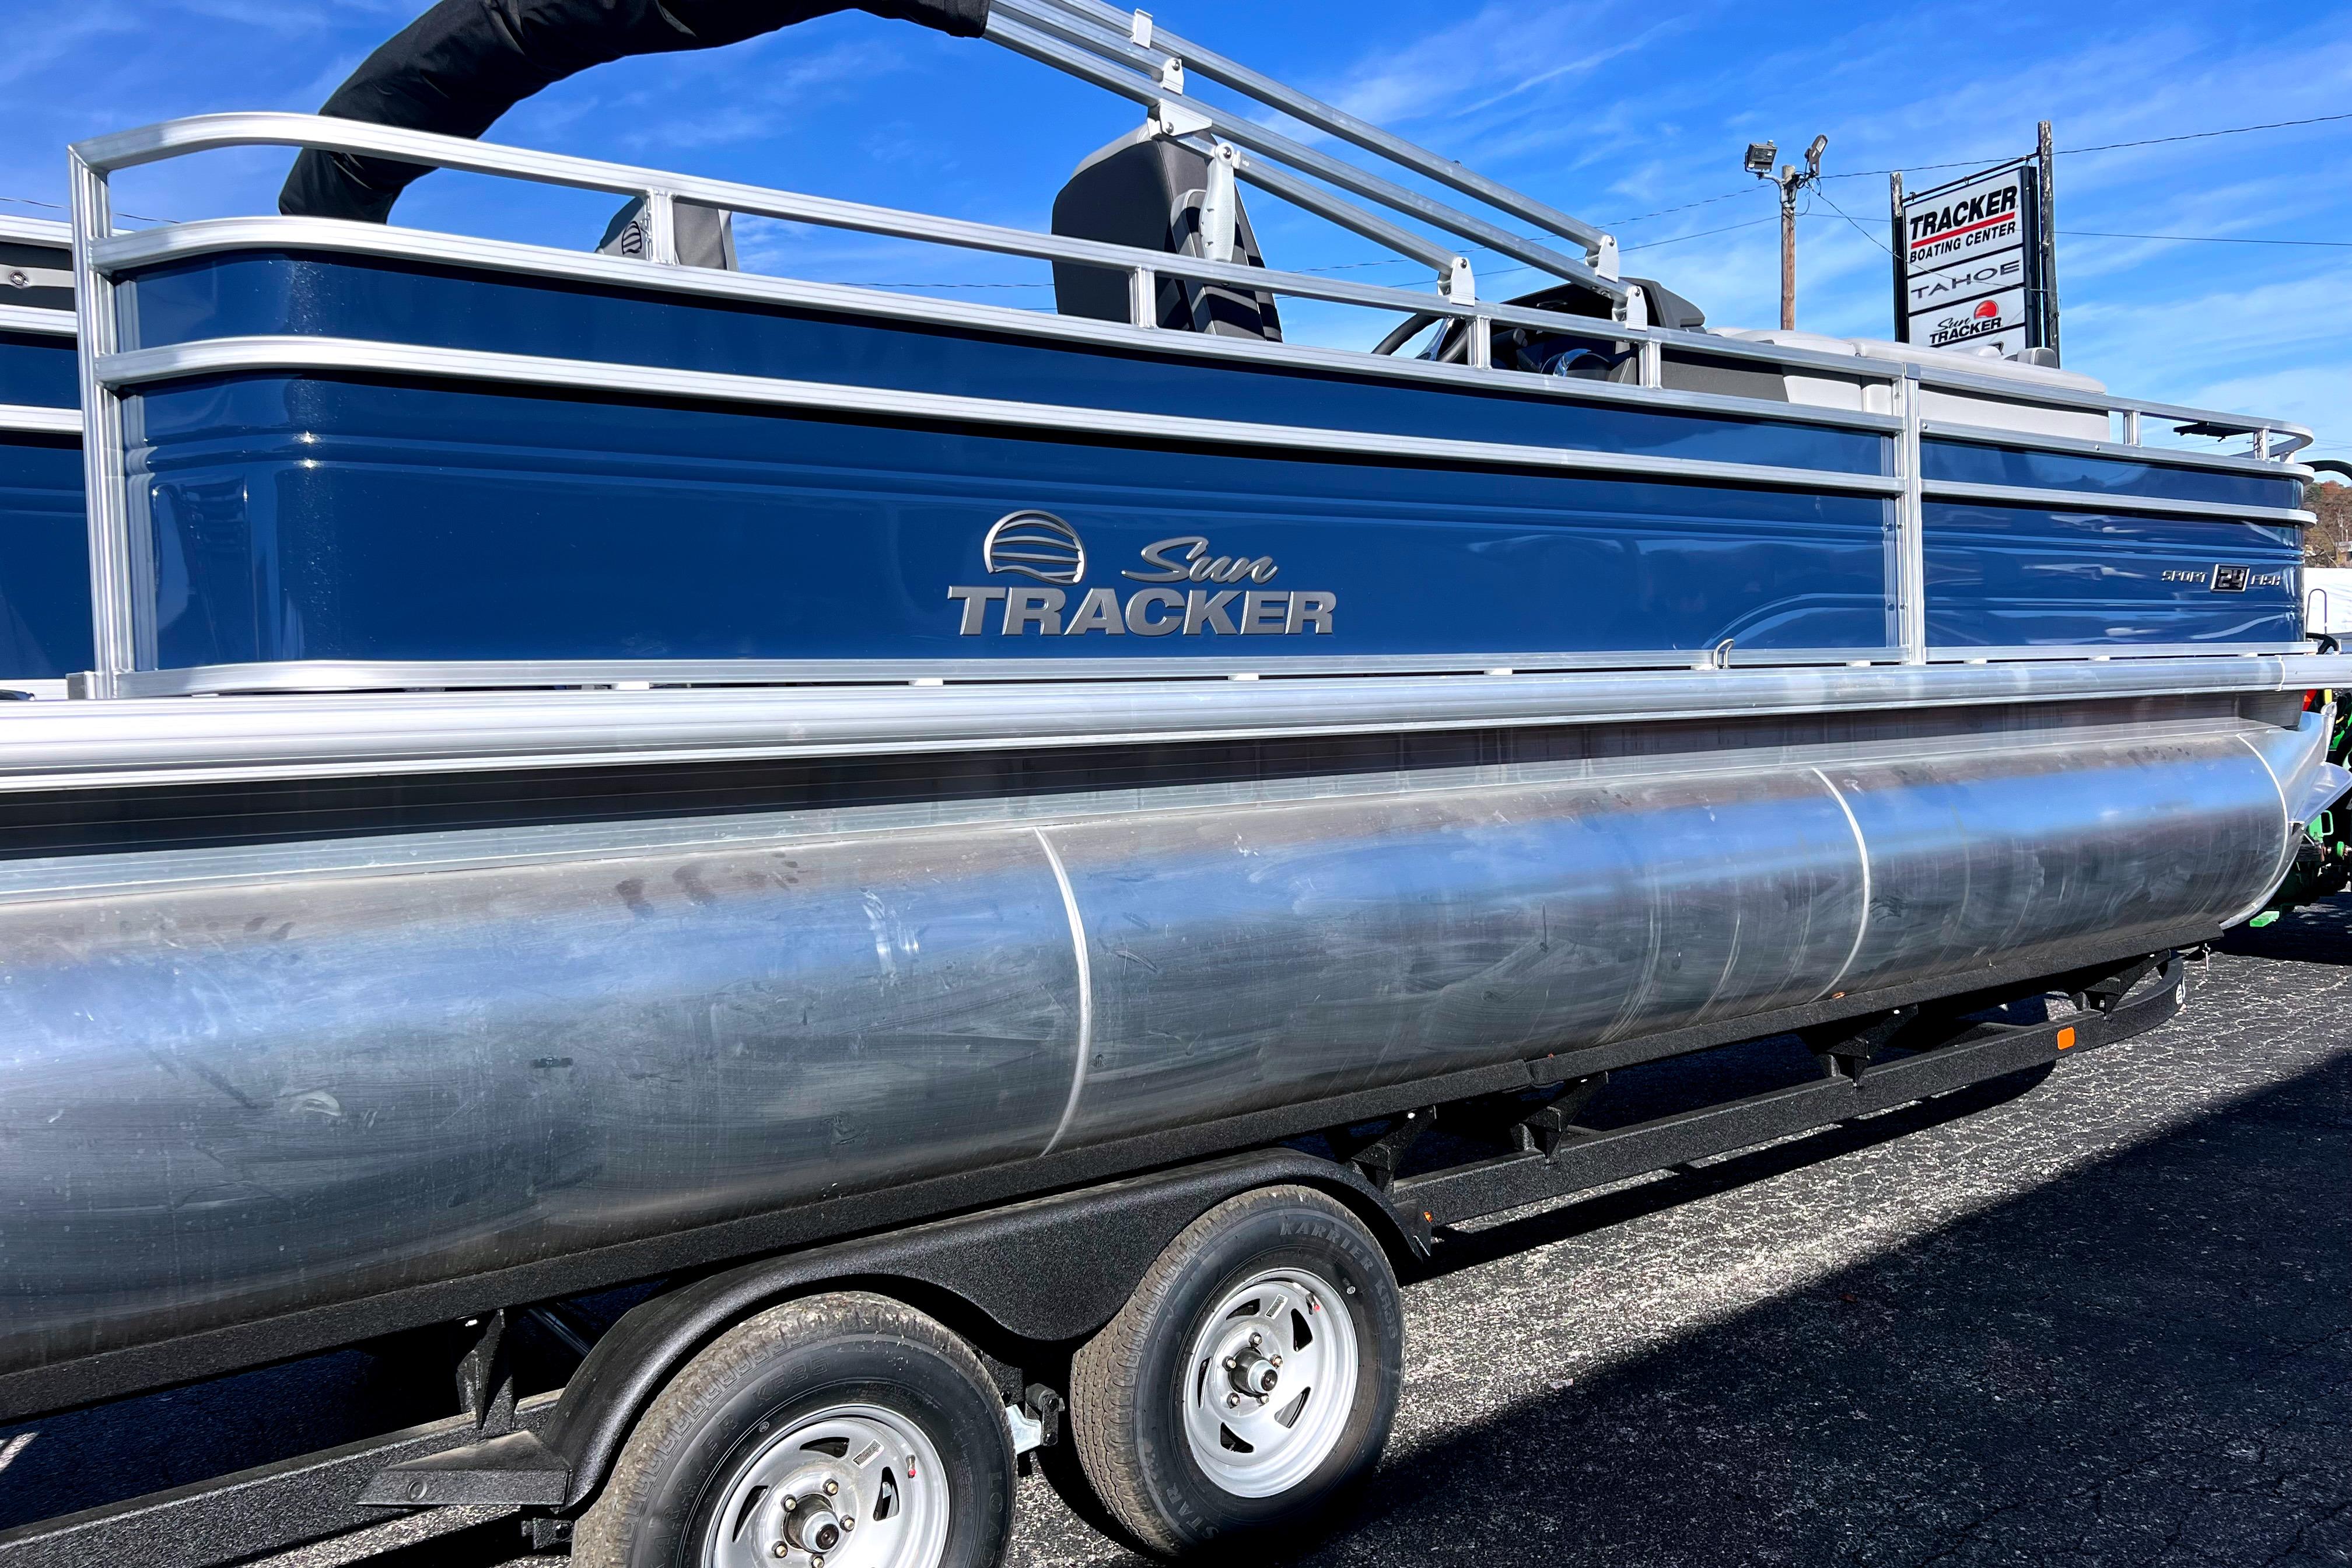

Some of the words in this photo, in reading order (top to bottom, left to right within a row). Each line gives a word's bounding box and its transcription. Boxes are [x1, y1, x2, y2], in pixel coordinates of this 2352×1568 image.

[1910, 186, 2017, 240] TRACKER
[1910, 237, 1961, 262] BOATING
[1966, 221, 2016, 247] CENTER
[1910, 260, 2020, 299] TAHOE
[1929, 317, 2002, 344] TRACKER
[1934, 317, 1971, 332] Sun
[1122, 536, 1278, 584] Sun
[2218, 569, 2245, 588] 24
[947, 586, 1337, 636] TRACKER
[1279, 1222, 1374, 1272] KARRIER
